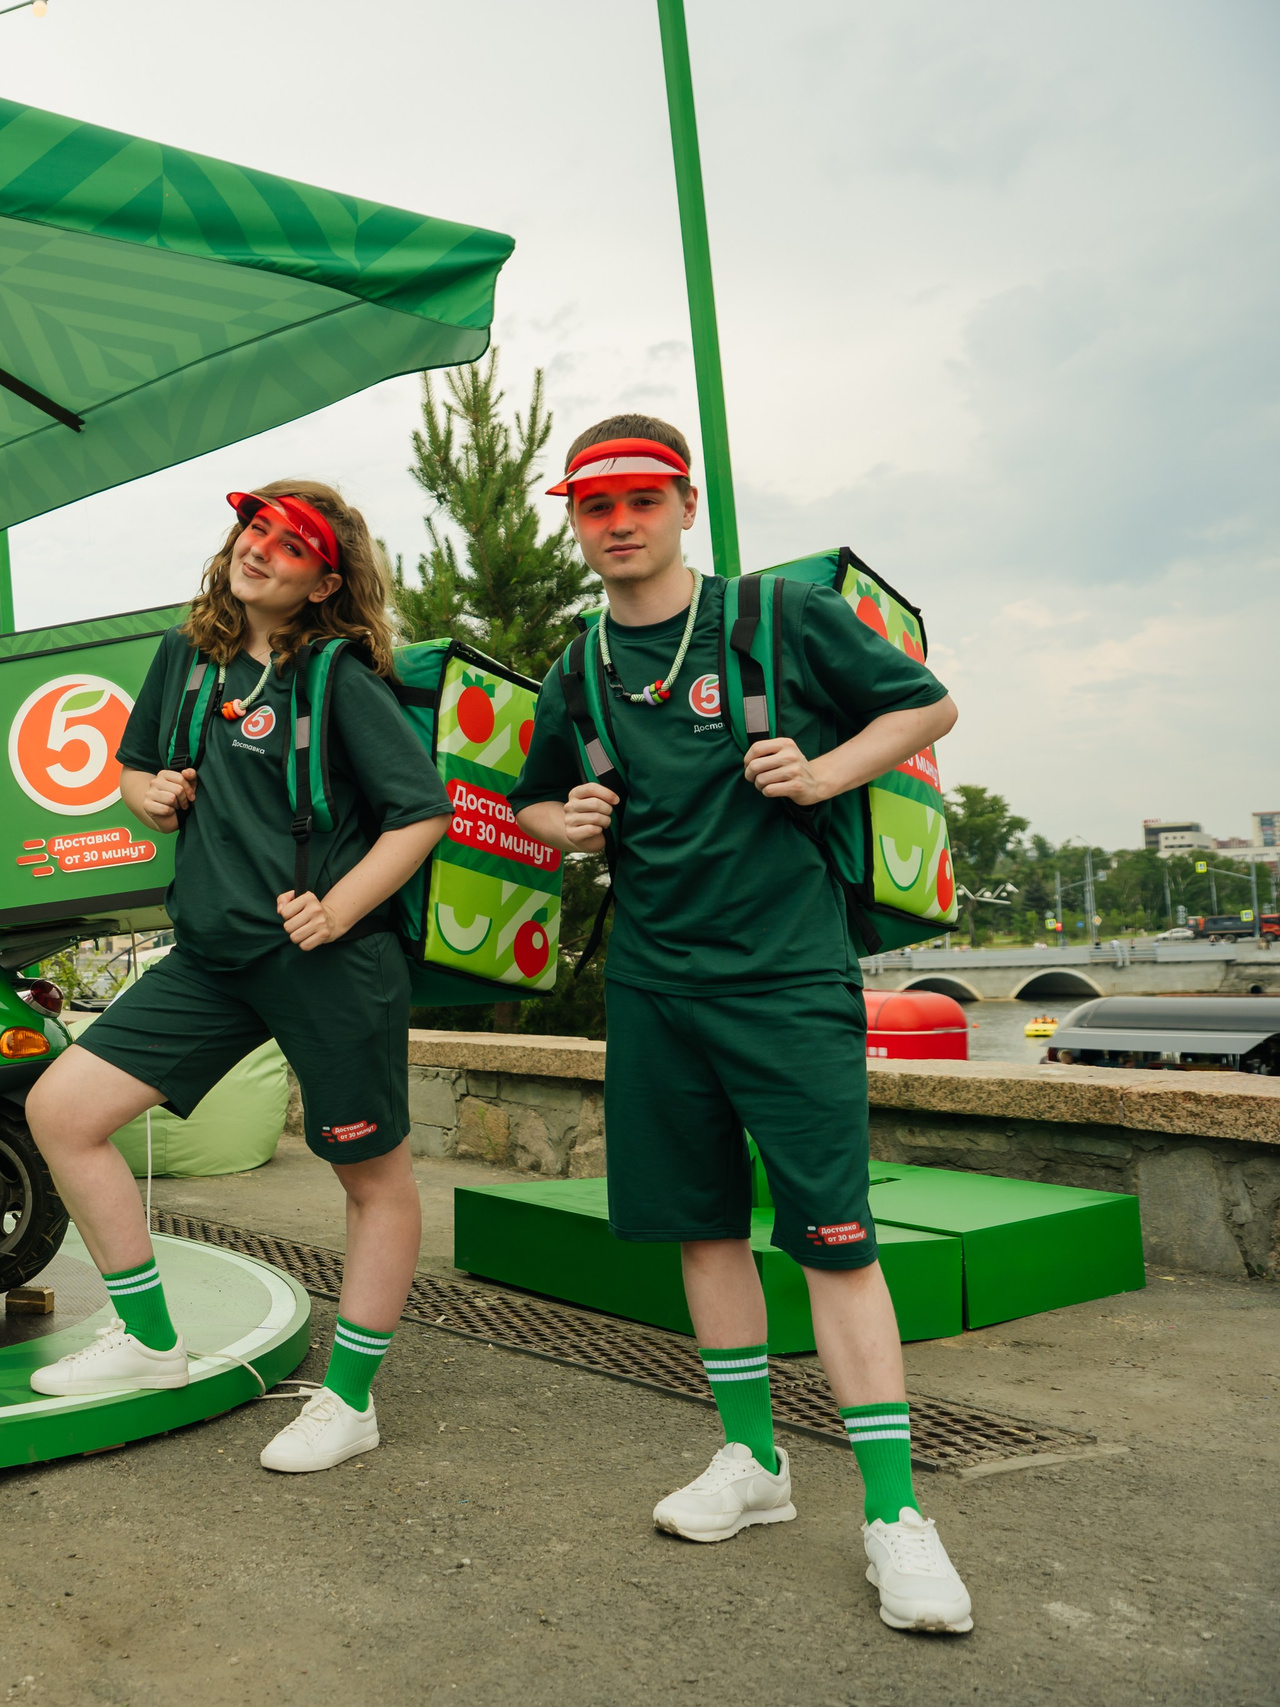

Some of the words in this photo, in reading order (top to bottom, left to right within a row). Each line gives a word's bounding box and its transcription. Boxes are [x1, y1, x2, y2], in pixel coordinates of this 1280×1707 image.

[693, 722, 724, 734] Доста
[231, 739, 266, 755] Доставка
[453, 784, 517, 824] Достав
[54, 832, 120, 852] Доставка
[452, 816, 474, 837] от
[476, 820, 496, 844] 30
[500, 832, 554, 865] минут
[64, 854, 81, 865] от
[83, 850, 99, 862] 30
[101, 845, 146, 859] минут
[334, 1122, 365, 1134] Доставка
[821, 1224, 857, 1235] Доставка
[838, 1234, 848, 1242] 30
